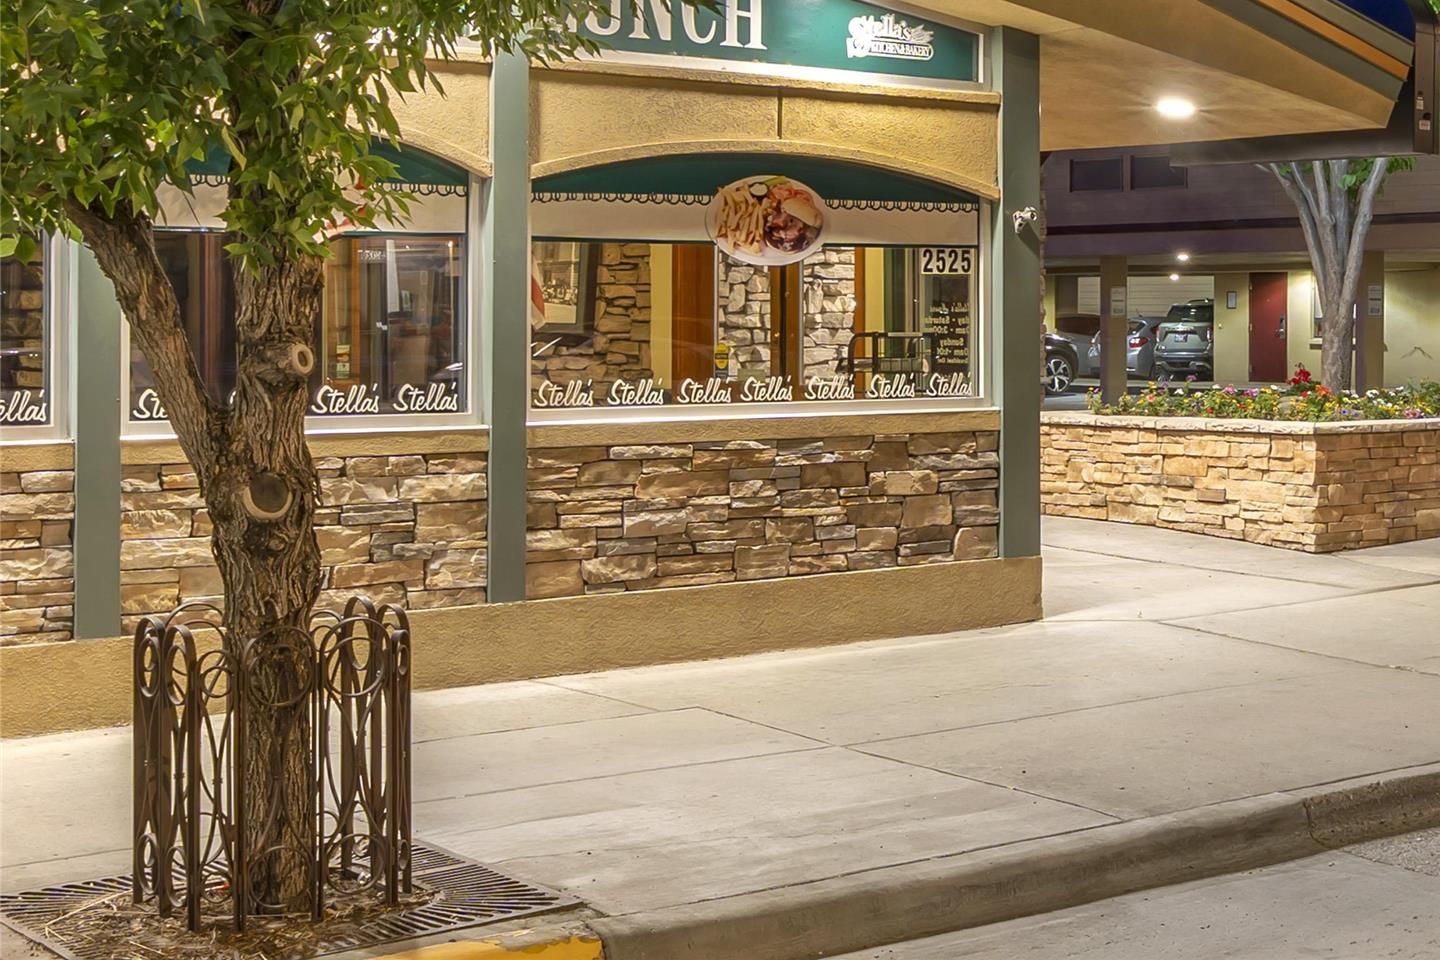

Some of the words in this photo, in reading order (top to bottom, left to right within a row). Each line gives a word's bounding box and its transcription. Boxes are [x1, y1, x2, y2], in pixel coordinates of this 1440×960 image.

[922, 249, 972, 274] 2525
[311, 383, 379, 414] Stella's
[393, 382, 458, 412] Stella's
[534, 378, 594, 407] Stella's
[607, 377, 665, 405] Stella's
[677, 377, 732, 404] Stella's
[740, 375, 793, 402] Stella's
[804, 373, 855, 400] Stella's
[865, 372, 916, 398] Stella's
[926, 371, 973, 397] Stella's
